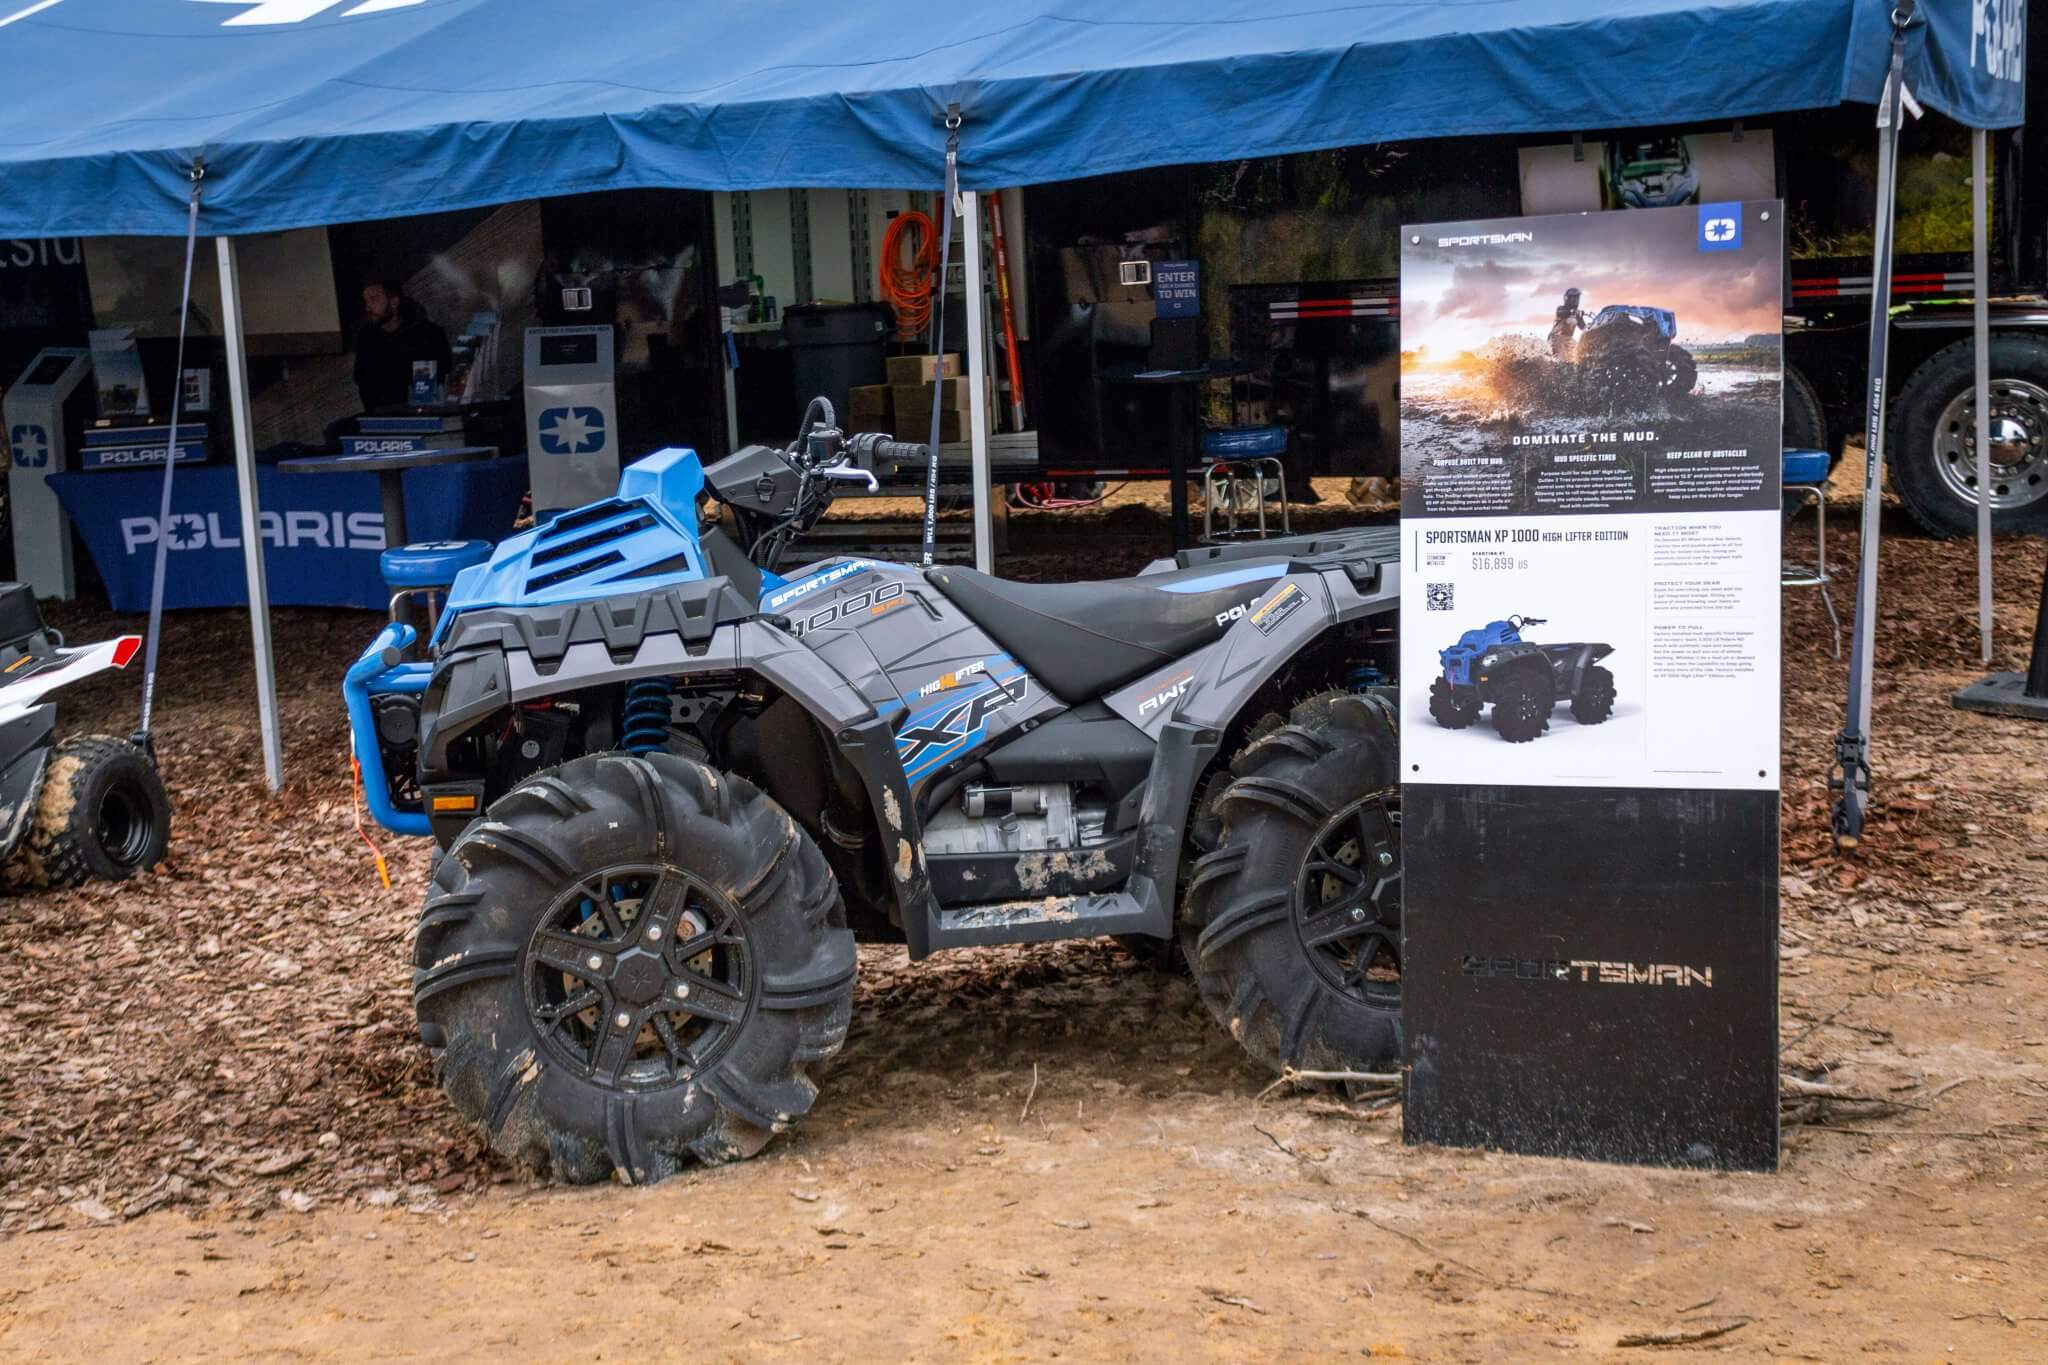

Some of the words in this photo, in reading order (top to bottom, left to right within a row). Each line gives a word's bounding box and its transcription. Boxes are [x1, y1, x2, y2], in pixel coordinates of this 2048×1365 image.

[1438, 232, 1533, 248] SPORTSMAN
[1158, 272, 1195, 282] ENTER
[1159, 290, 1171, 298] TO
[1173, 289, 1196, 298] WIN
[1512, 434, 1585, 445] DOMINATE
[1591, 433, 1616, 443] THE
[1623, 431, 1659, 442] MUD.
[354, 440, 414, 452] POLARIS
[100, 447, 186, 463] POLARS
[120, 511, 386, 554] POLARIS
[1426, 530, 1491, 544] SPORTSMAN
[1494, 530, 1508, 543] XP
[1511, 529, 1539, 542] 1000
[1542, 532, 1562, 542] HIGH
[1565, 532, 1592, 541] LIFTER
[1595, 531, 1628, 541] EDITION
[1472, 557, 1514, 570] $16,899
[1518, 560, 1528, 569] US
[772, 559, 876, 608] SPORTSMAN
[794, 581, 904, 640] 1000
[895, 674, 1028, 767] XP
